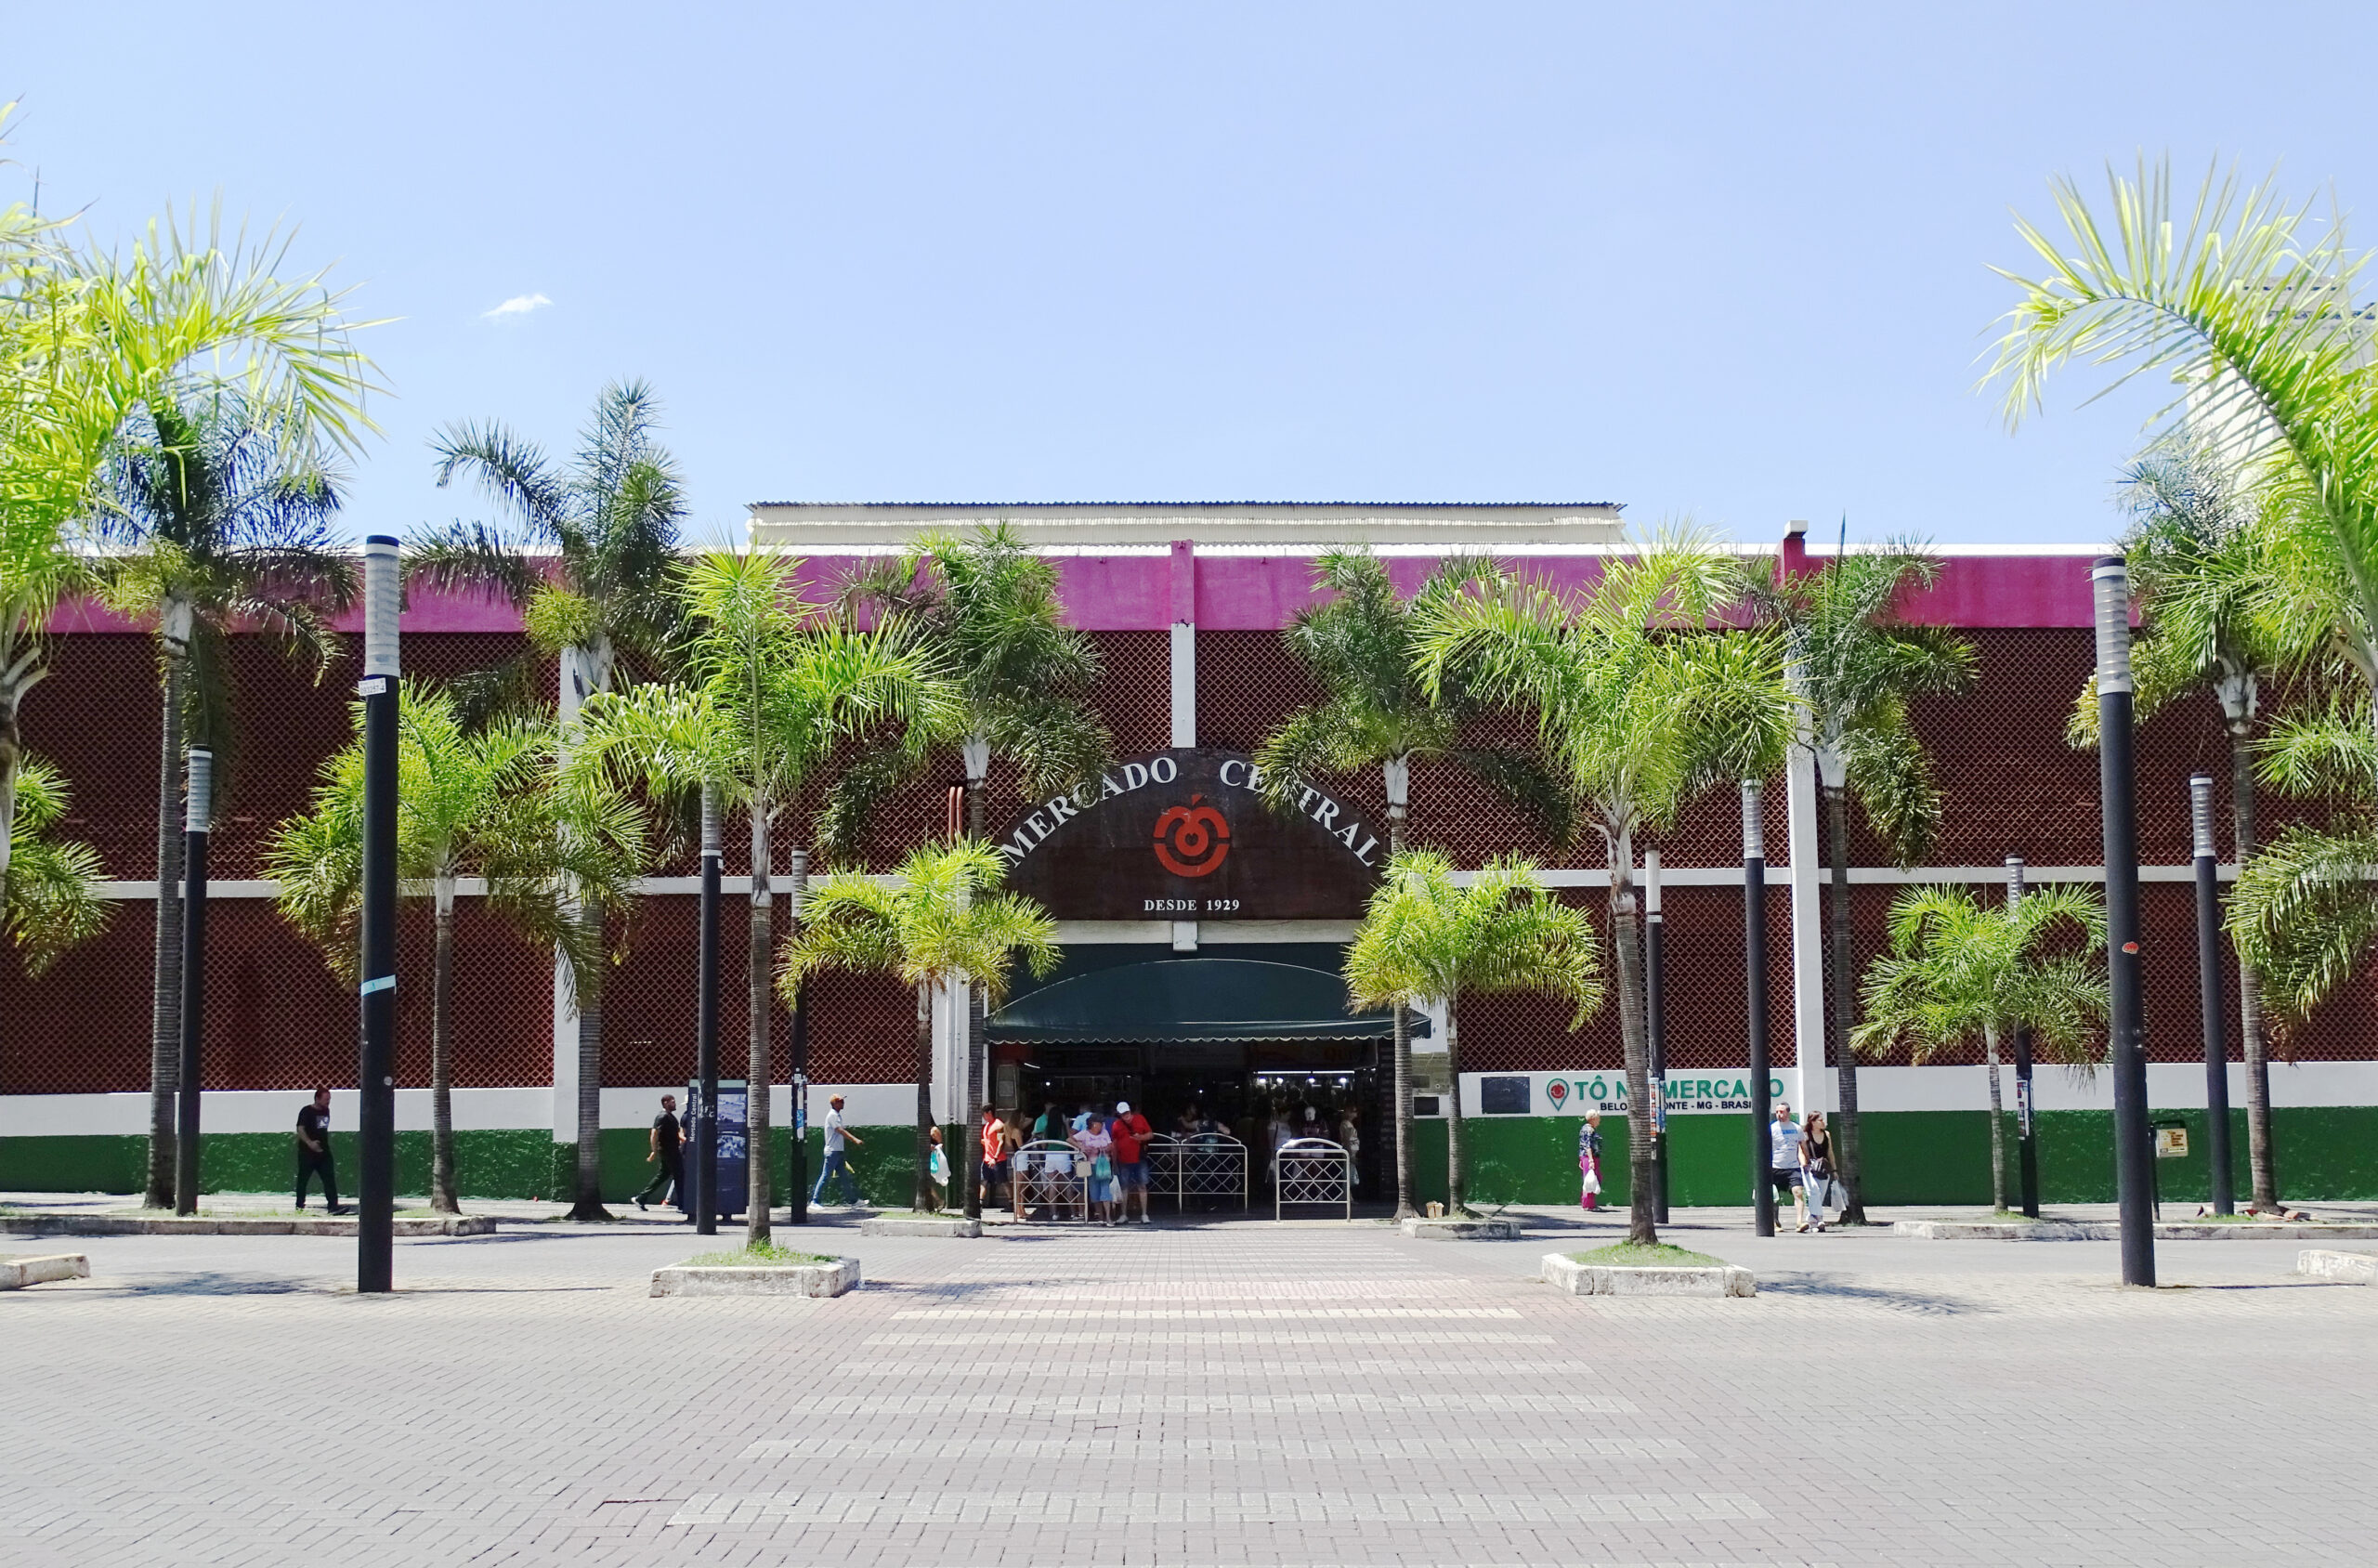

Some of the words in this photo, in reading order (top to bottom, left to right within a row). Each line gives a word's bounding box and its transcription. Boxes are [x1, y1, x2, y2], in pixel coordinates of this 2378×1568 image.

[1220, 759, 1380, 868] CETRAL
[1143, 899, 1197, 910] DESDE
[1206, 899, 1240, 910] 1929
[1574, 1075, 1608, 1101] TÔ
[1664, 1078, 1784, 1099] MERCAO
[1600, 1103, 1627, 1111] BELO
[1696, 1101, 1713, 1110] MG
[1720, 1100, 1752, 1109] BRASI
